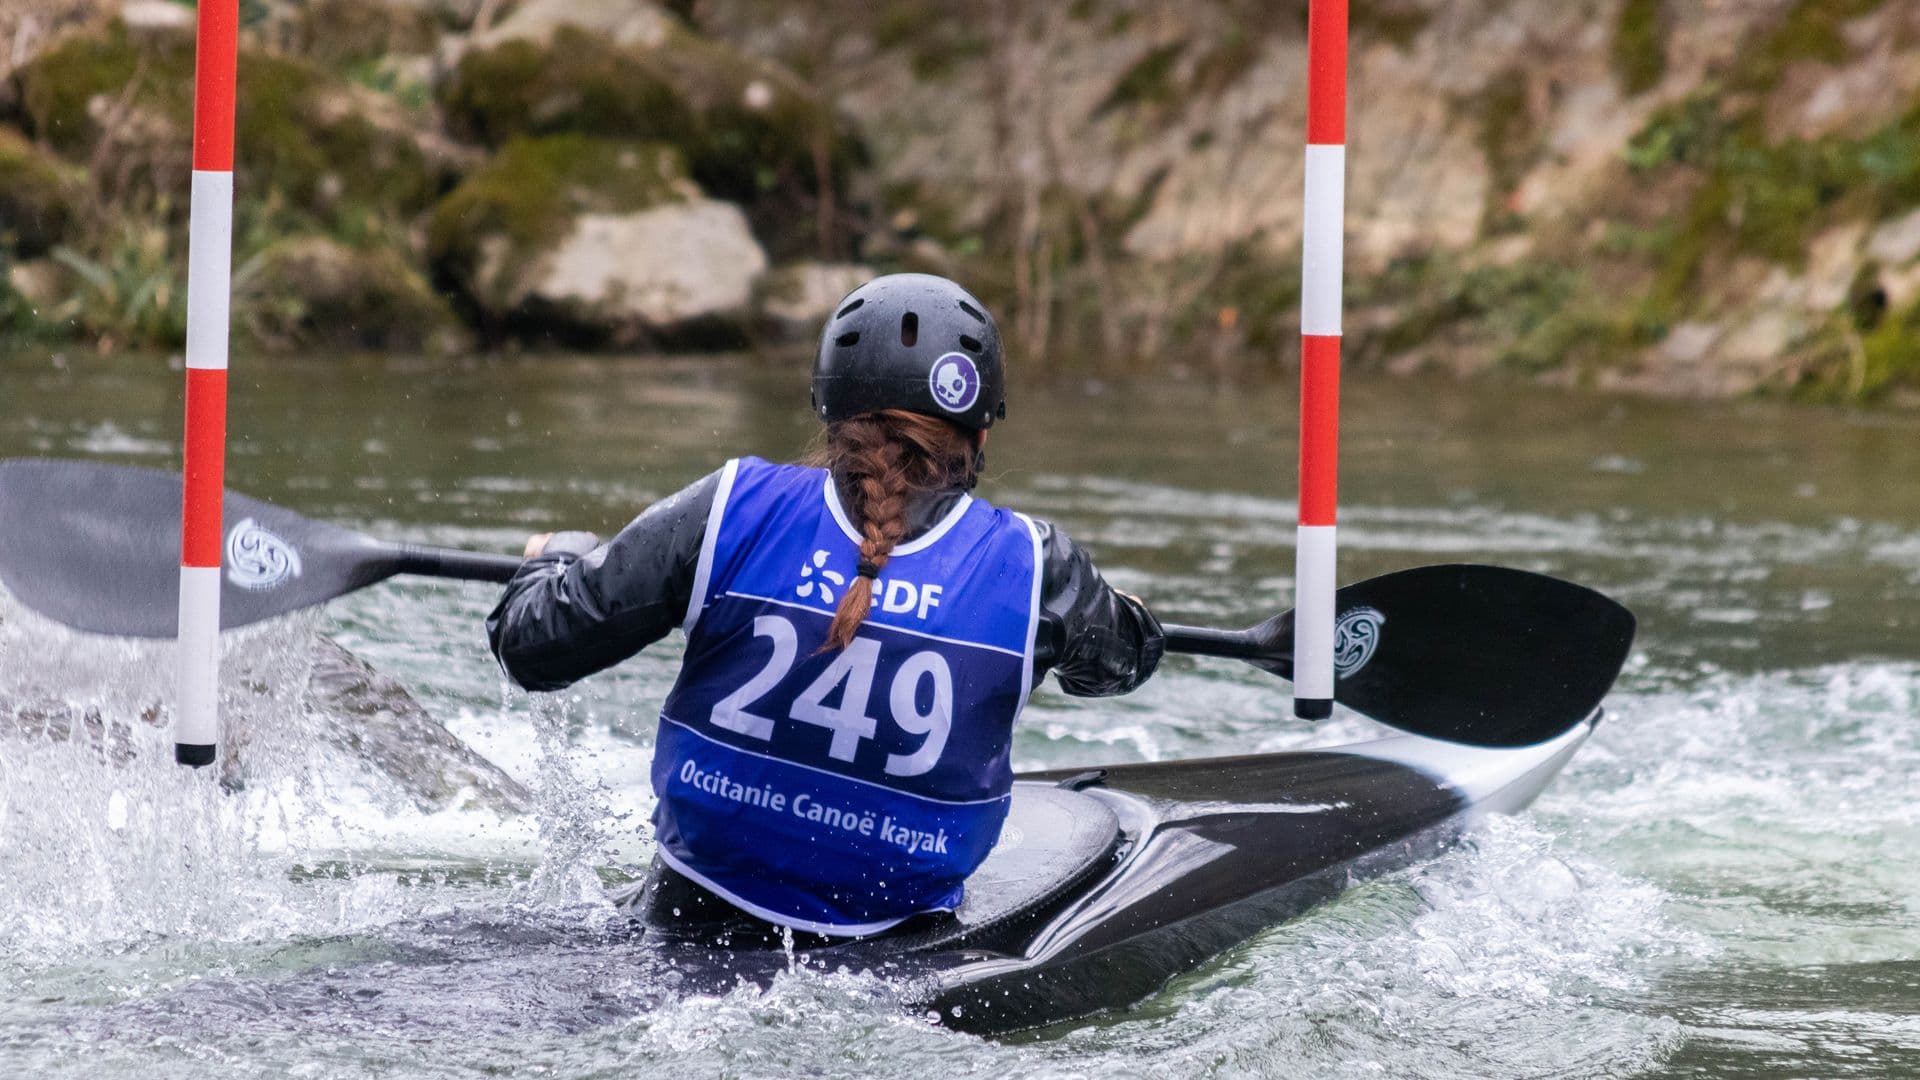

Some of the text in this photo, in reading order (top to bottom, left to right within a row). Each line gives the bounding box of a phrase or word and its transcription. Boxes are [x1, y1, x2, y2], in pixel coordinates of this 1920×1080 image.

[709, 615, 953, 777] 249
[680, 759, 949, 854] Occitanie Canoë kayak
